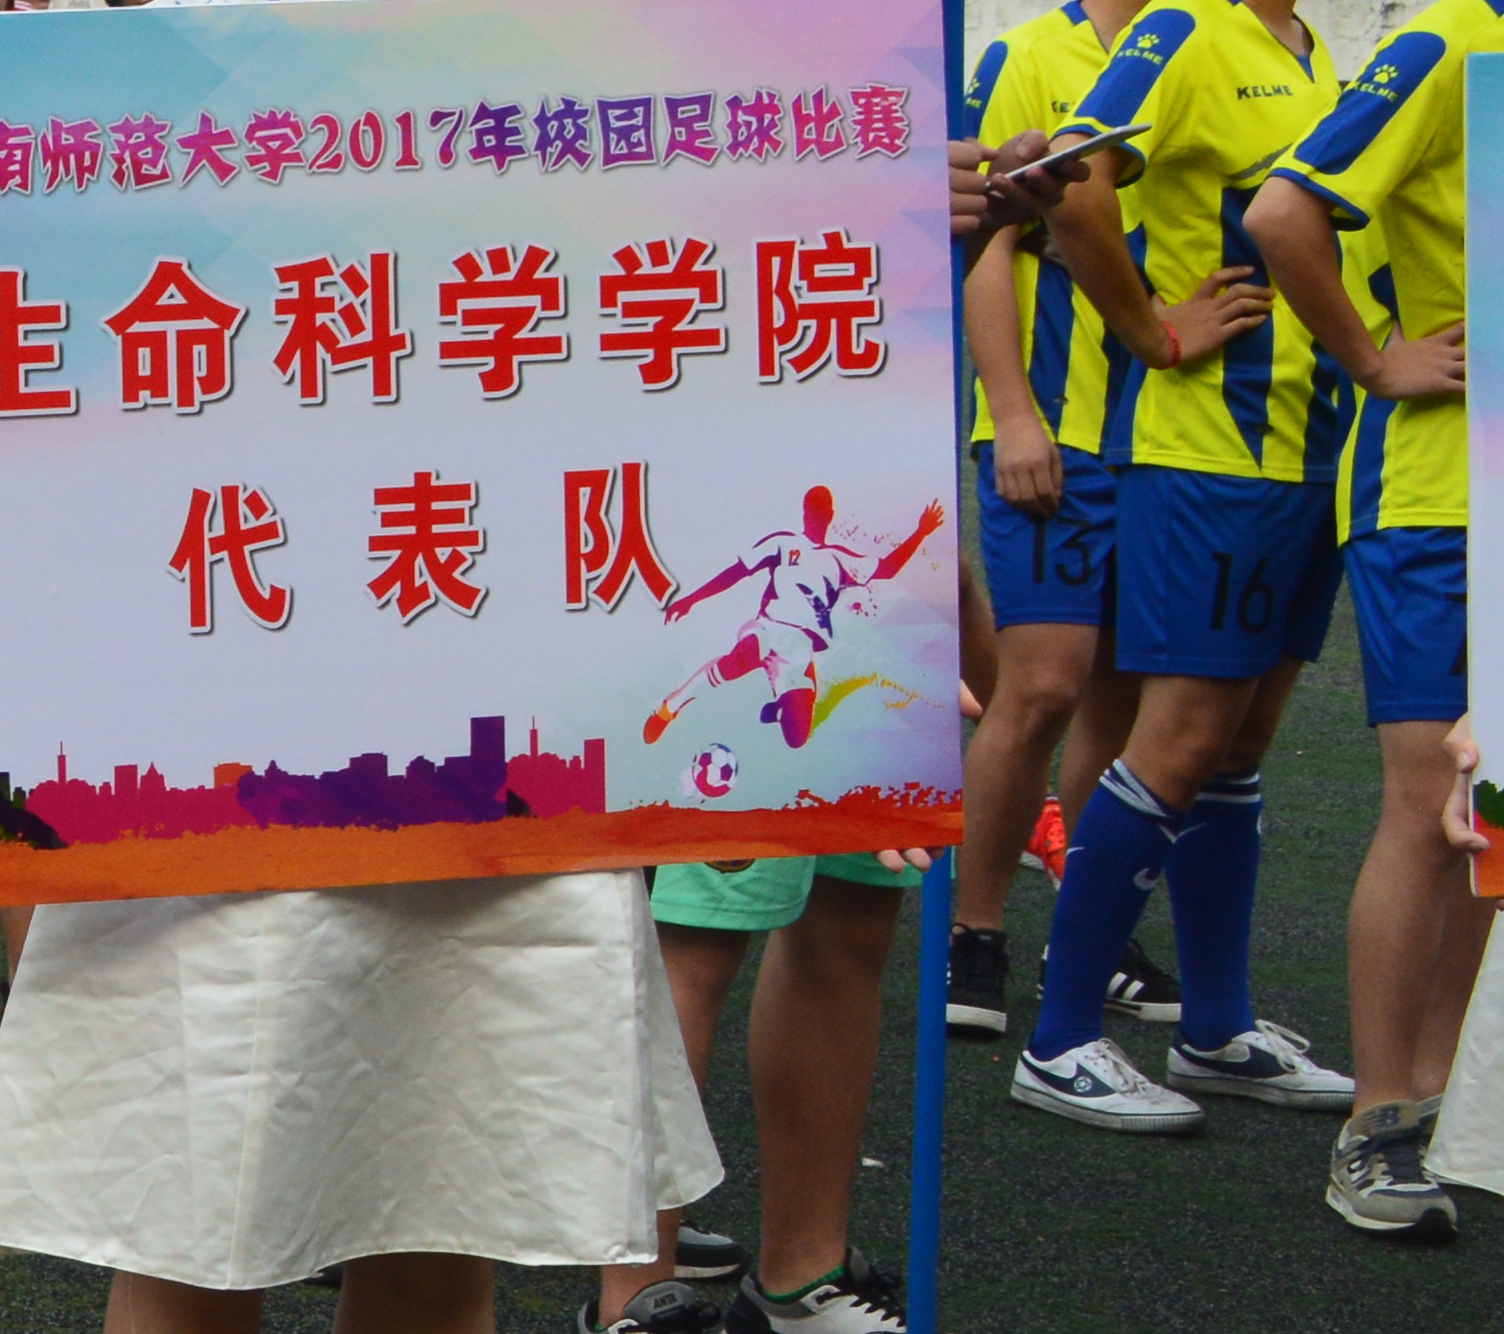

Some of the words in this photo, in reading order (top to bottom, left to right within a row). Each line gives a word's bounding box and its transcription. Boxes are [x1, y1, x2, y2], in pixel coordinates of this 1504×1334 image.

[1117, 47, 1164, 66] KELME
[1236, 85, 1294, 100] KELME
[1350, 80, 1399, 103] KELME
[167, 461, 674, 636] 代表队
[1033, 516, 1094, 587] 13
[1210, 552, 1276, 634] 16
